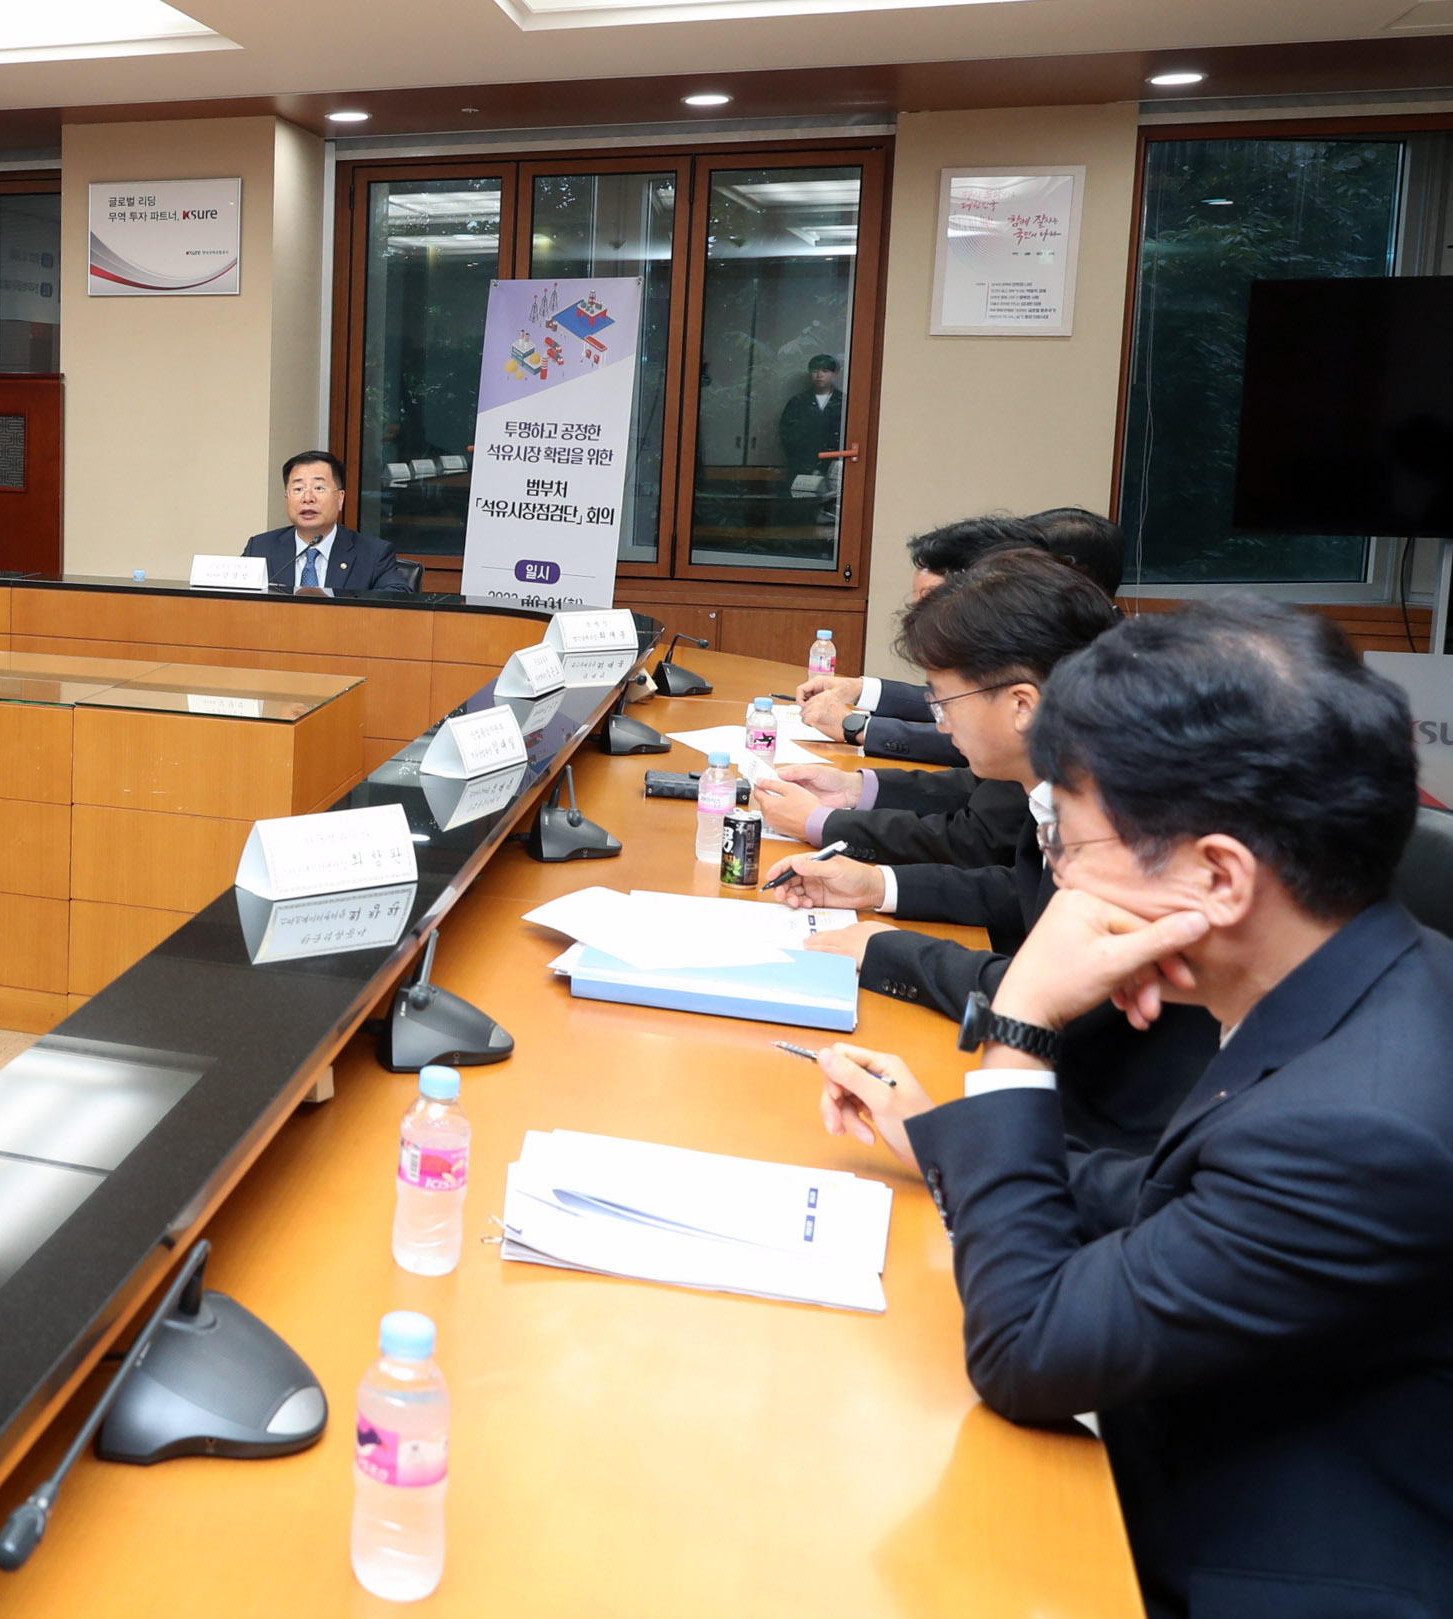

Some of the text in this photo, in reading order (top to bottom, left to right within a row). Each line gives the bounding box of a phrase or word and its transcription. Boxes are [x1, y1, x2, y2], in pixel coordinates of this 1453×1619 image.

[108, 195, 156, 208] 글로벌 리딩
[108, 211, 126, 222] 무역
[129, 211, 147, 222] 투자
[505, 421, 601, 441] 투명하고 공정한
[488, 444, 614, 466] 석유시장 확립을 위한
[526, 478, 568, 498] 범부처
[475, 497, 615, 525] 「석유시장점검단」 회의
[525, 564, 550, 580] 일시
